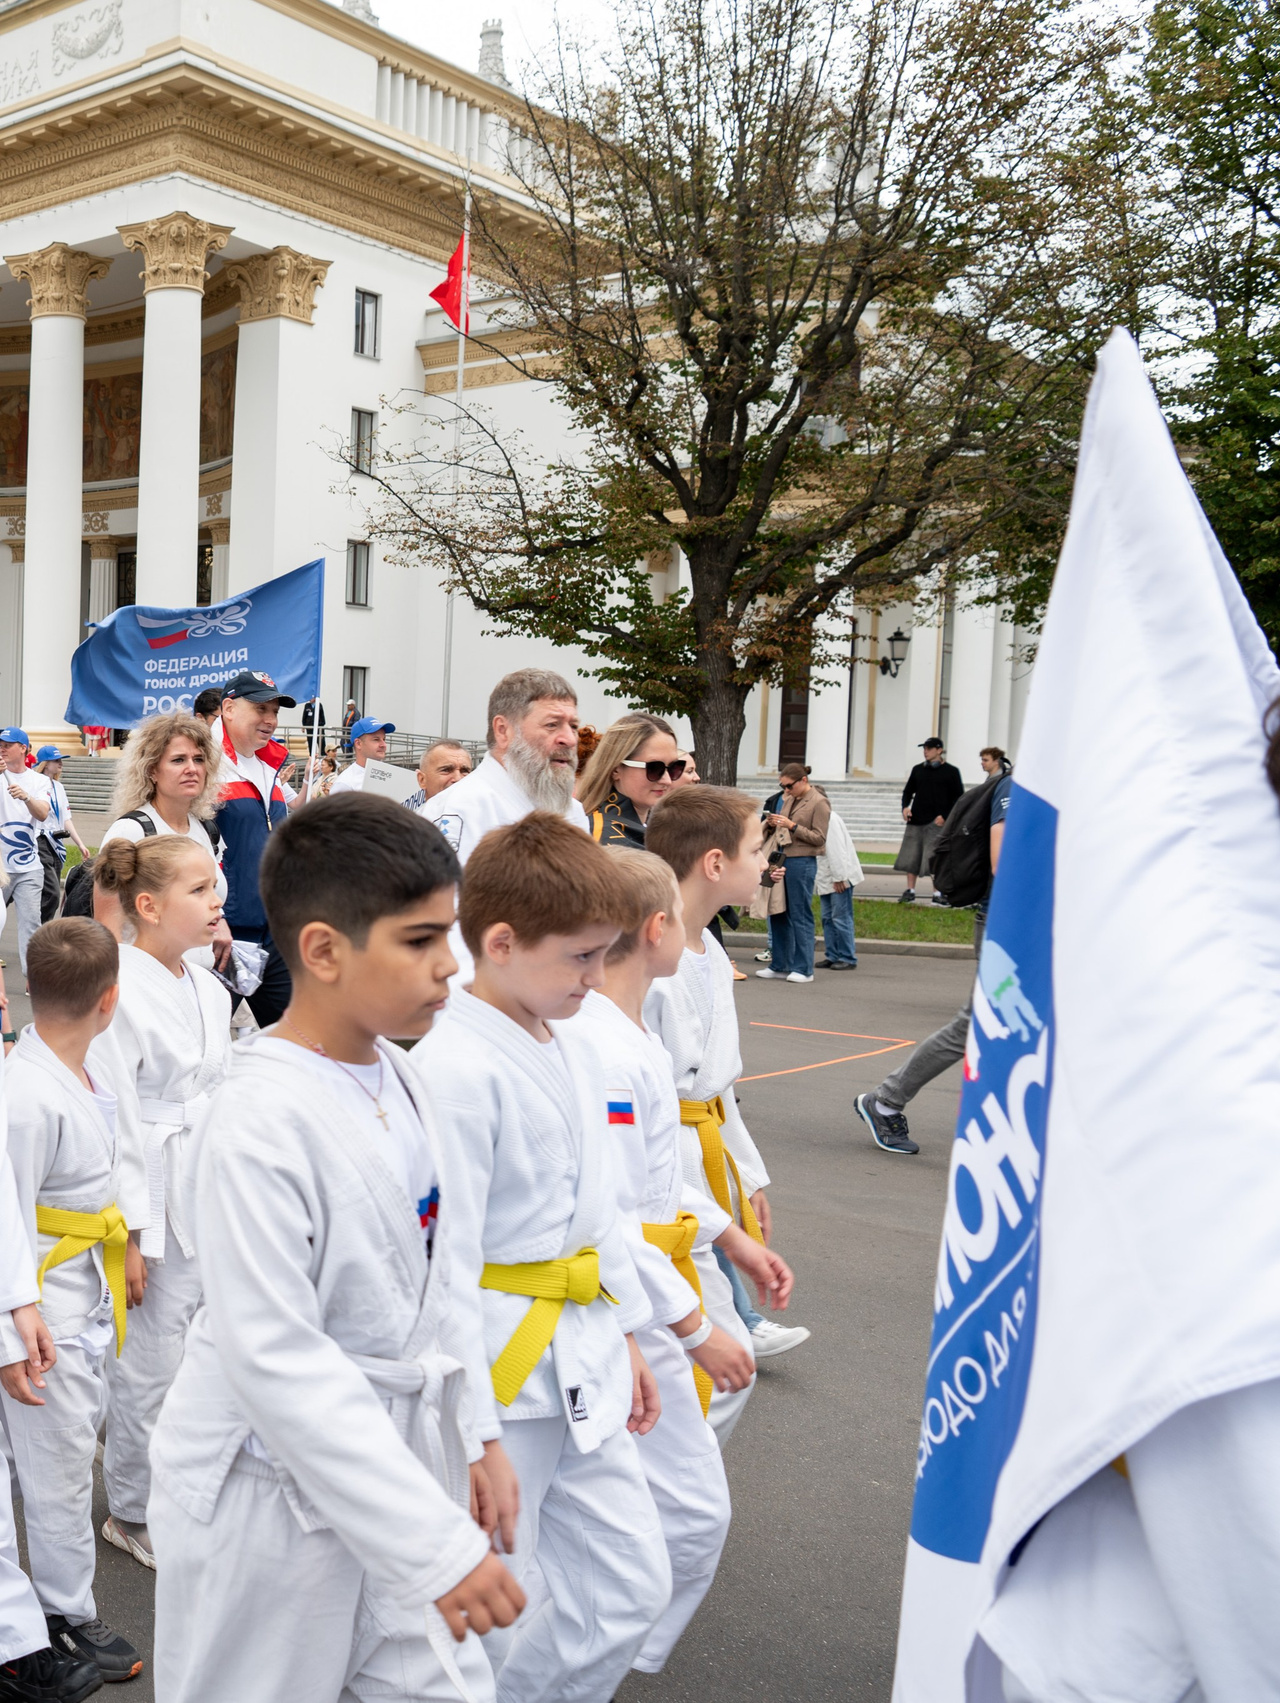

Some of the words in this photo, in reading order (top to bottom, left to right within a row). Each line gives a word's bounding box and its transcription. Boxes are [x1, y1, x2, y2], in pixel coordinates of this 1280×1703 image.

[144, 647, 249, 675] ФЕДЕРАЦИЯ
[144, 676, 187, 690] ГОНОК
[142, 691, 202, 715] РОС
